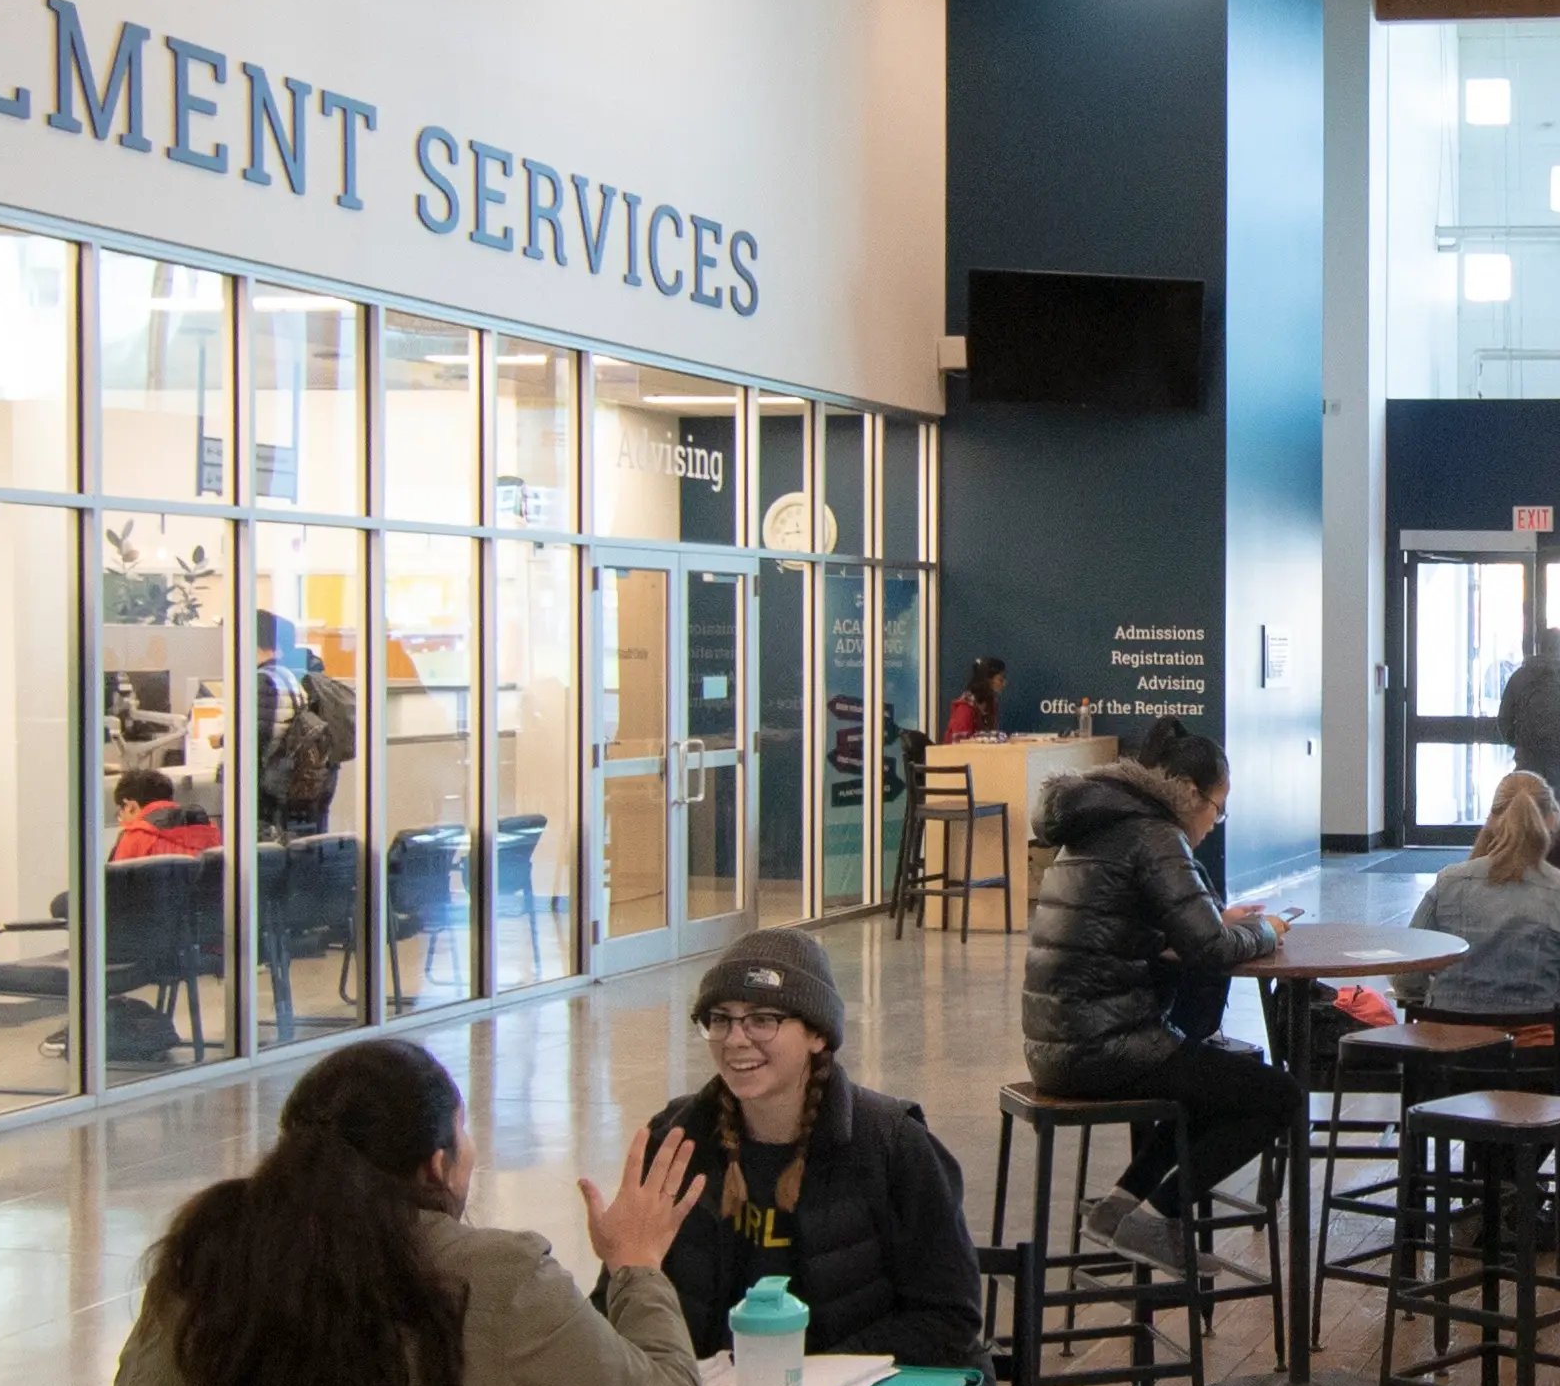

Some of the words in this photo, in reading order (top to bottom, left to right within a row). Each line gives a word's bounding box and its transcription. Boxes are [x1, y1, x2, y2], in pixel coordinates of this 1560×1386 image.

[413, 124, 763, 319] SERVICES
[617, 427, 723, 493] Advising
[1518, 509, 1549, 530] EXIT
[832, 618, 907, 636] ACAMIC
[1114, 625, 1205, 641] Admissions
[834, 638, 904, 654] ADVNG
[1111, 650, 1205, 668] Registration
[1137, 675, 1206, 694] Advising
[1040, 699, 1078, 715] Offic
[1088, 699, 1104, 715] of
[1106, 700, 1132, 715] the
[1134, 700, 1205, 718] Registrar
